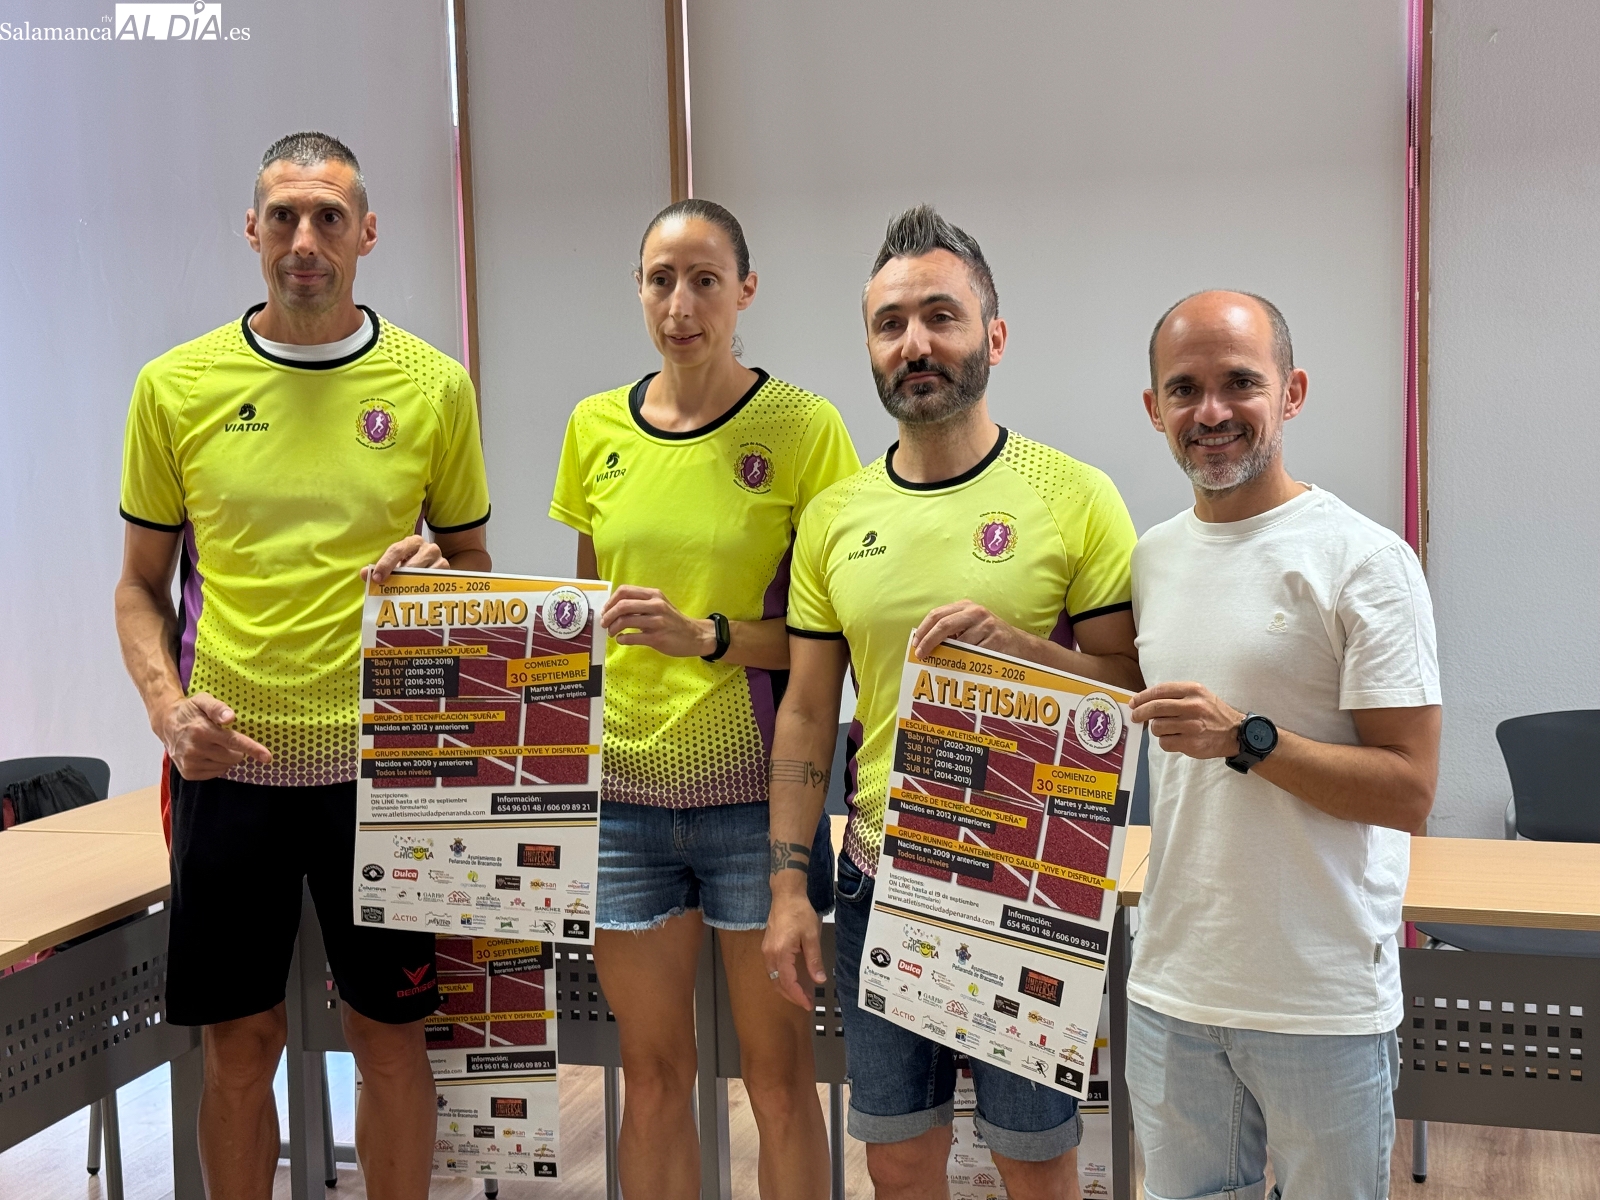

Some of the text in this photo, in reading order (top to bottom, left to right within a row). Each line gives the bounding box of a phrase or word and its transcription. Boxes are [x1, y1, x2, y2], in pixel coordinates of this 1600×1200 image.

[224, 422, 270, 432] VIATOR
[596, 468, 627, 483] VIATOR
[848, 545, 887, 560] VIATOR
[379, 582, 490, 596] Temporada 2025 2026
[376, 598, 528, 628] ATLETISMO
[412, 658, 454, 666] (2020-2019)
[524, 658, 569, 670] COMIENZO
[919, 655, 1026, 681] emporada 2025 2026
[405, 668, 444, 676] (2018-2017)
[510, 670, 586, 684] 30 SEPTIEMBRE
[405, 678, 444, 686] (2016-2015)
[406, 688, 445, 696] (2014-2013)
[912, 669, 1060, 726] ATLETISMO
[374, 724, 400, 732] Nacidos
[905, 721, 936, 733] ESCUELA
[946, 730, 983, 743] ATLETISMO
[440, 748, 497, 756] MANTENIMIENTO
[944, 740, 984, 756] (2020-2019)
[935, 749, 974, 764] (2018-2017)
[934, 760, 973, 775] (2016-2015)
[933, 770, 972, 786] (2014-2013)
[1051, 770, 1097, 784] COMIENZO
[1036, 779, 1113, 801] 30 SEPTIEMBRE
[497, 795, 542, 803] Información:
[901, 791, 928, 803] GRUPOS
[930, 797, 939, 805] DE
[940, 800, 992, 817] TECNIFICACIÓN
[1054, 799, 1077, 808] Martes
[900, 801, 991, 828] Nacidos en 2012 y anteriores
[897, 849, 950, 868] Todos los niveles
[898, 829, 922, 840] GRUPO
[923, 835, 953, 848] RUNNING
[958, 844, 1015, 863] MANTENIMIENTO
[1016, 859, 1040, 871] SALUD
[1061, 869, 1066, 877] Y
[898, 840, 990, 869] Nacidos en 2009 y anteriores
[1007, 910, 1052, 927] Información:
[1007, 919, 1100, 951] 654 96 01 48 606 09 89 21
[476, 946, 540, 959] 30 SEPTIEMBRE
[899, 961, 921, 975] Dulca
[1024, 975, 1058, 999] UNIVERSAL
